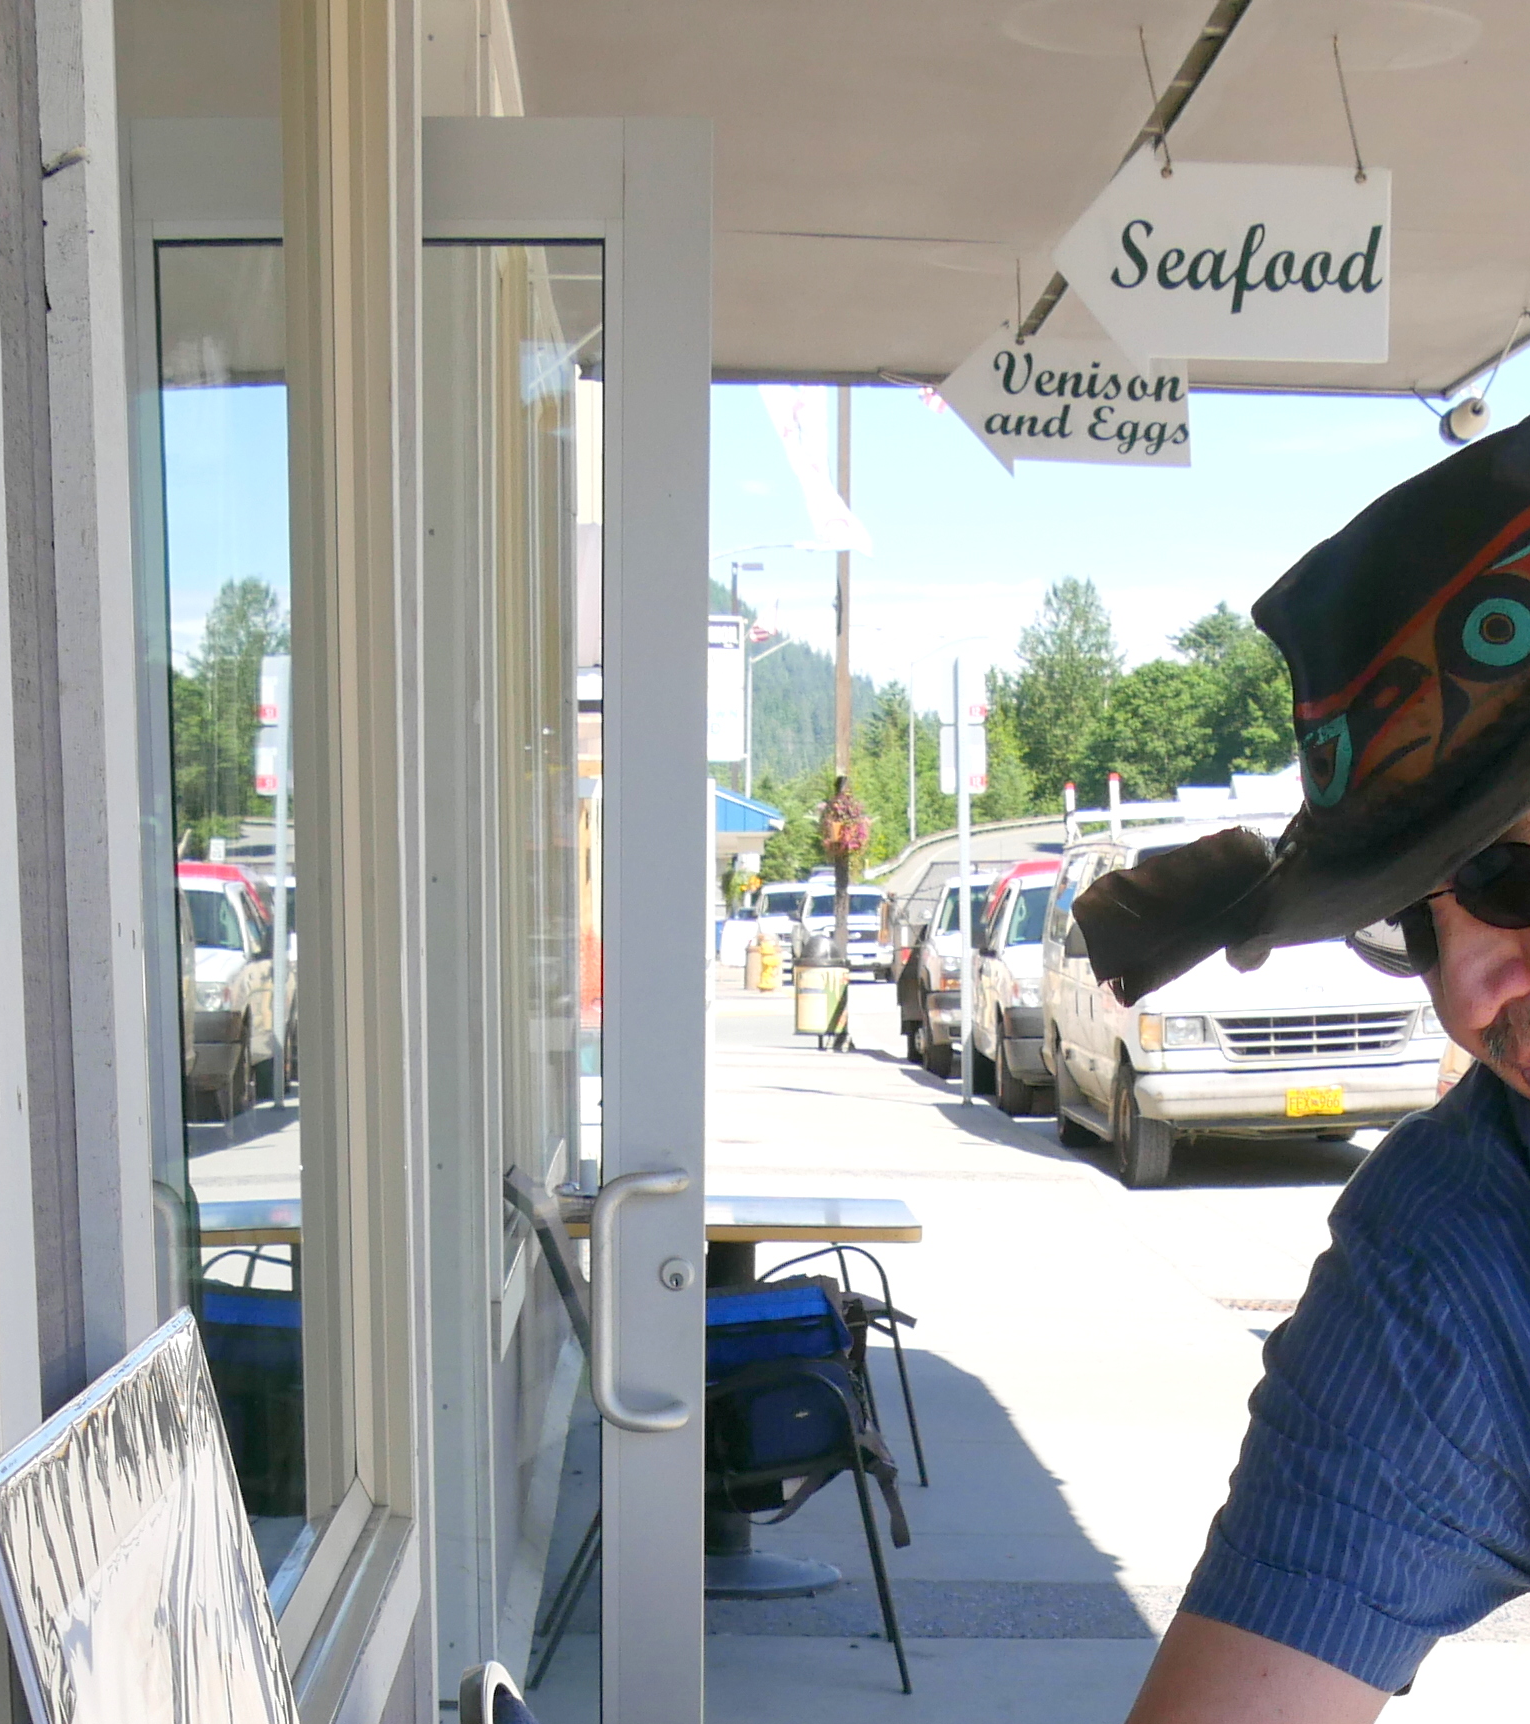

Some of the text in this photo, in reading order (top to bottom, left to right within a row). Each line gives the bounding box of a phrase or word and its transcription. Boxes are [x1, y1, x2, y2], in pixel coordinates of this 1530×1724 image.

[1109, 218, 1383, 315] Seafood
[992, 350, 1185, 402] Venison
[983, 404, 1190, 456] and Eggs
